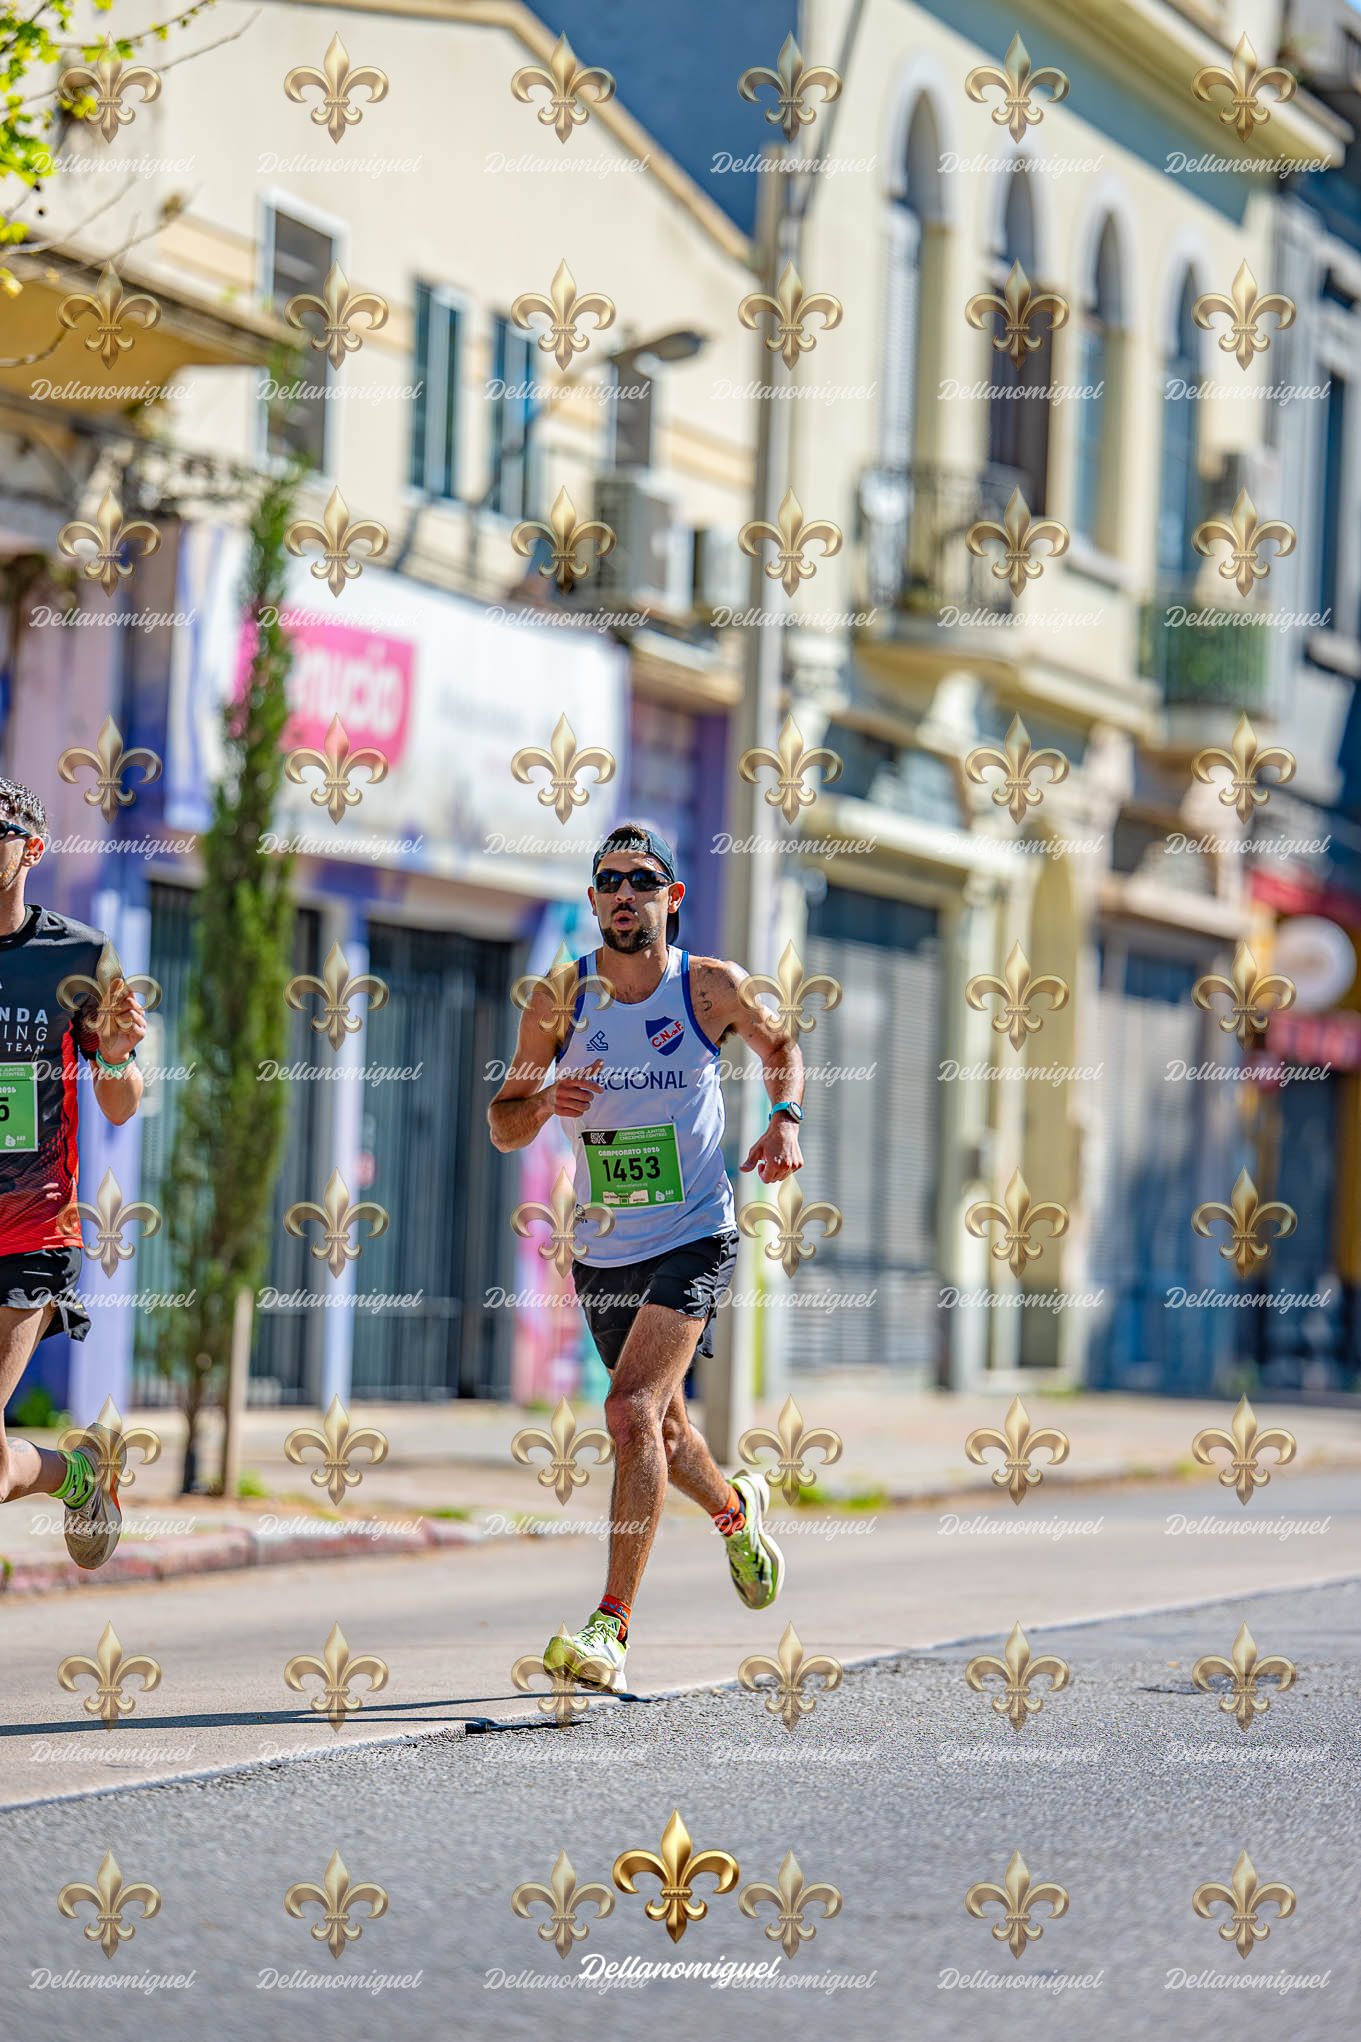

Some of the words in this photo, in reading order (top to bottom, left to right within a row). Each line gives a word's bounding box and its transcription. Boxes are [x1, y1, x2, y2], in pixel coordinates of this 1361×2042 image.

[3, 1024, 48, 1042] ING
[592, 1071, 687, 1090] ACIONAL
[590, 1132, 607, 1145] 5K
[598, 1148, 641, 1157] CAMPEONATO
[602, 1156, 661, 1182] 1453
